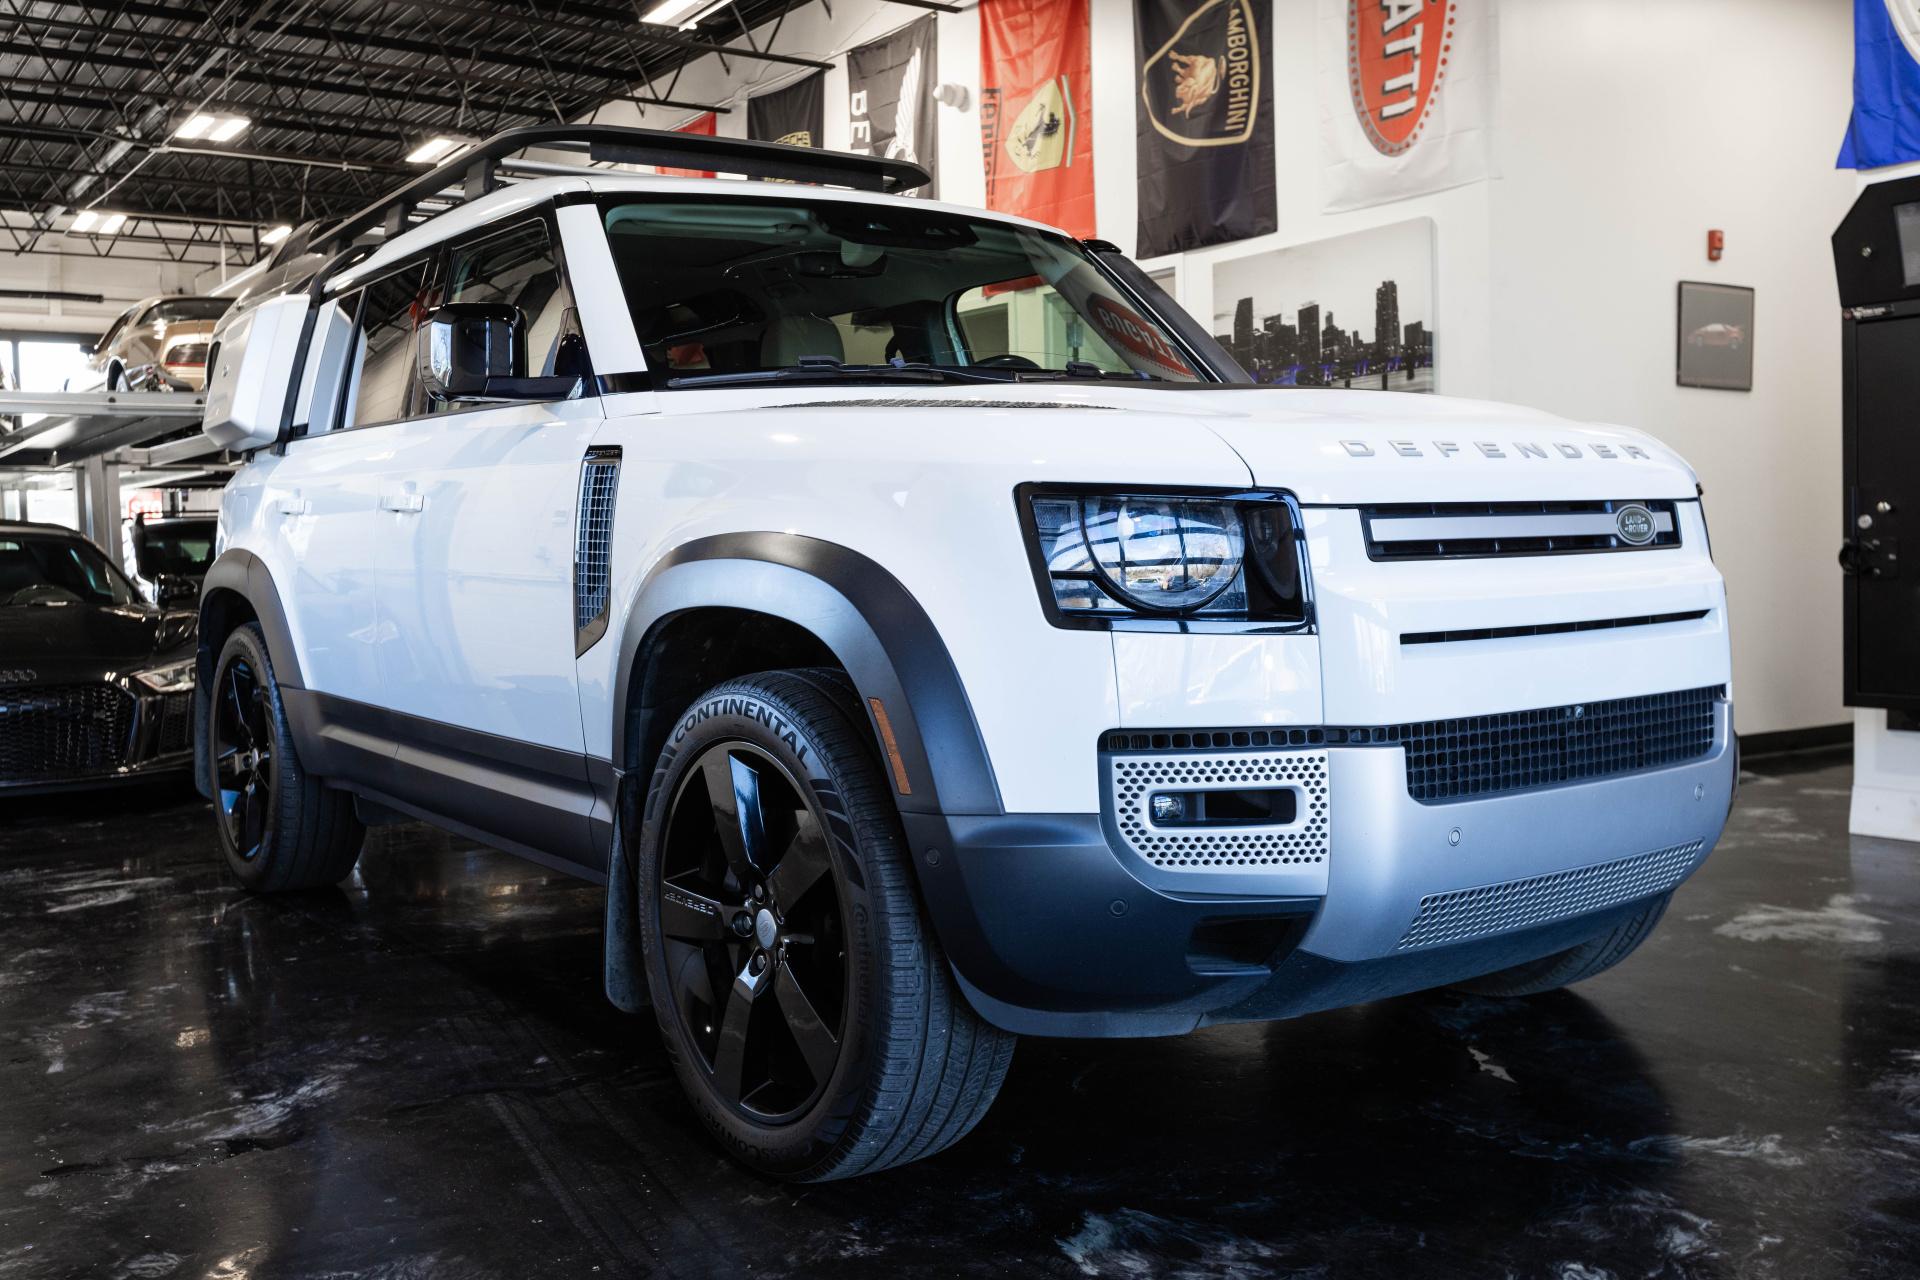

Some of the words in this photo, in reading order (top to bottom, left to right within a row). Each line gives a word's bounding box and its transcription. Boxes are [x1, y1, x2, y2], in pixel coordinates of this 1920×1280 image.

[1339, 440, 1650, 458] DEFENDER
[1625, 515, 1642, 525] LAND
[1628, 524, 1648, 533] ROVER
[674, 698, 808, 771] CONTINENTAL
